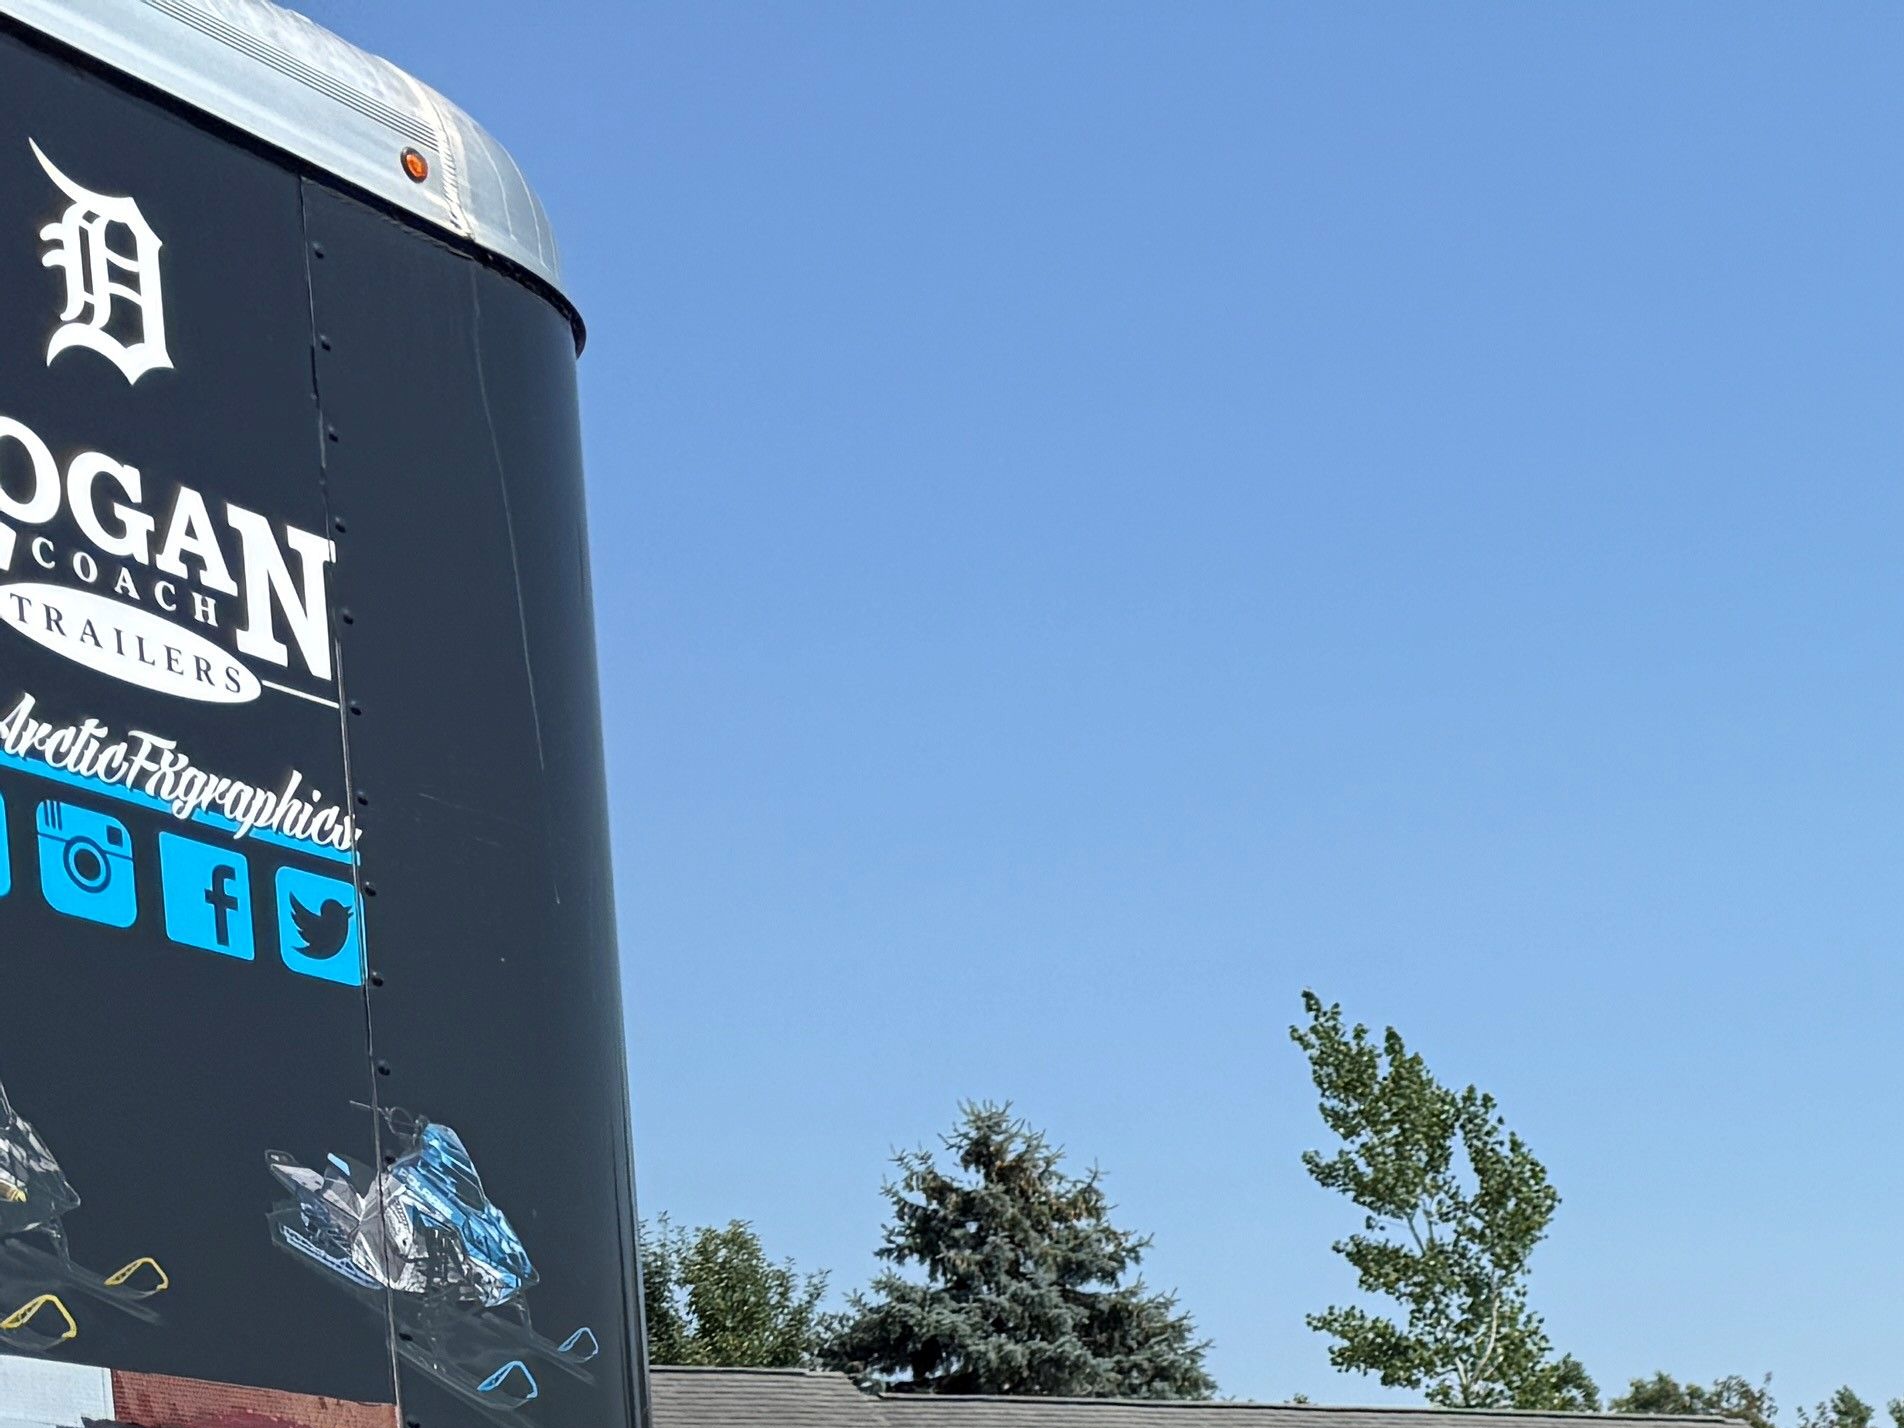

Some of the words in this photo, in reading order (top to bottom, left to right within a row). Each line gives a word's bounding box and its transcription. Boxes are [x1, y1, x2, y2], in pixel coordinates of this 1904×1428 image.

[0, 416, 337, 681] OGAN
[31, 537, 219, 627] COACH
[10, 593, 242, 693] TRAILERS
